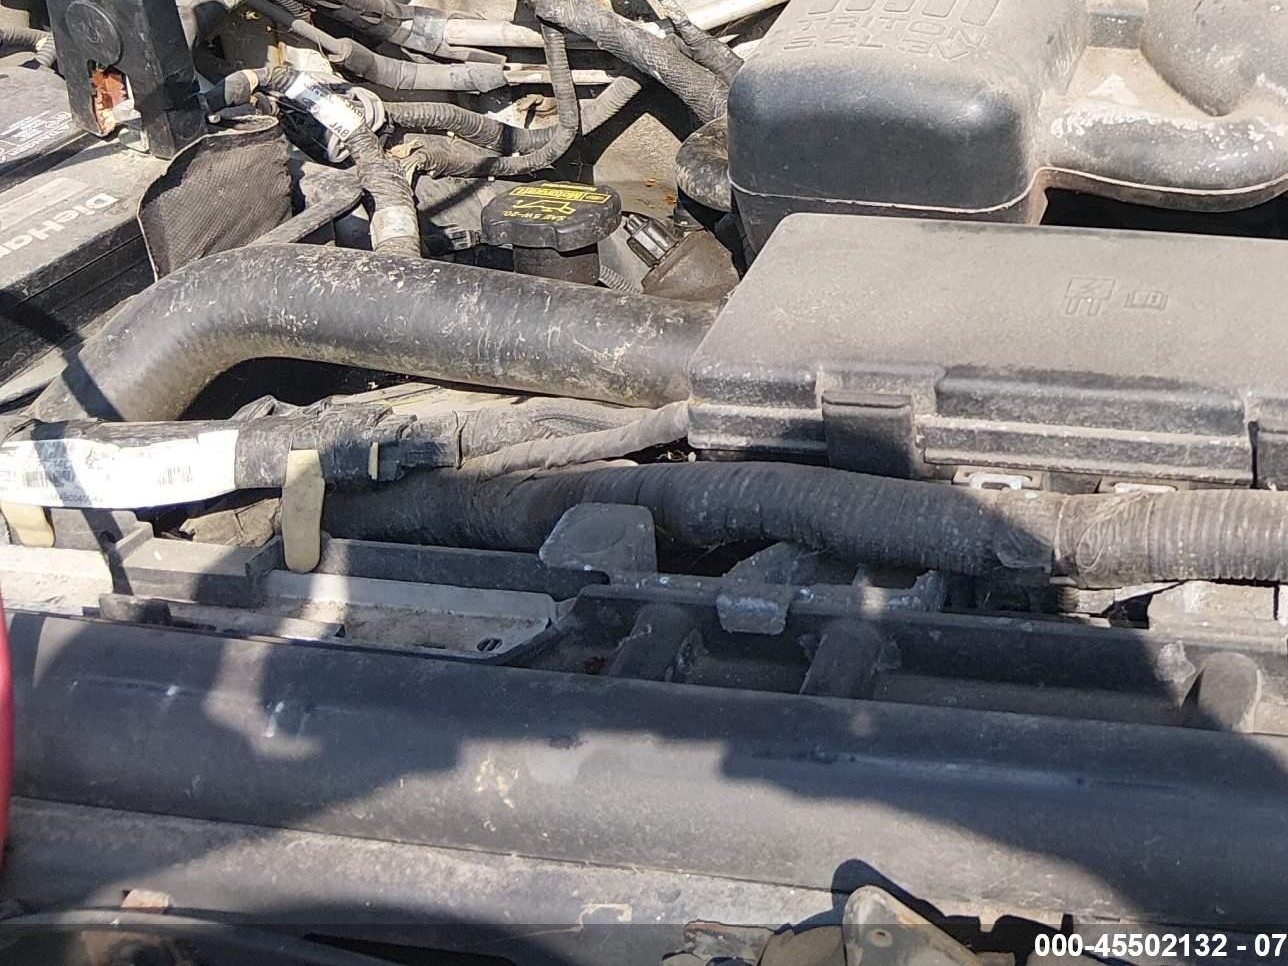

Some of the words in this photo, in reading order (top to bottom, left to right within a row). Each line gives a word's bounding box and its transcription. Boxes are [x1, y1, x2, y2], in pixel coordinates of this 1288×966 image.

[797, 16, 985, 50] TRITON
[516, 187, 583, 200] Motorcraft
[542, 213, 567, 222] SAE
